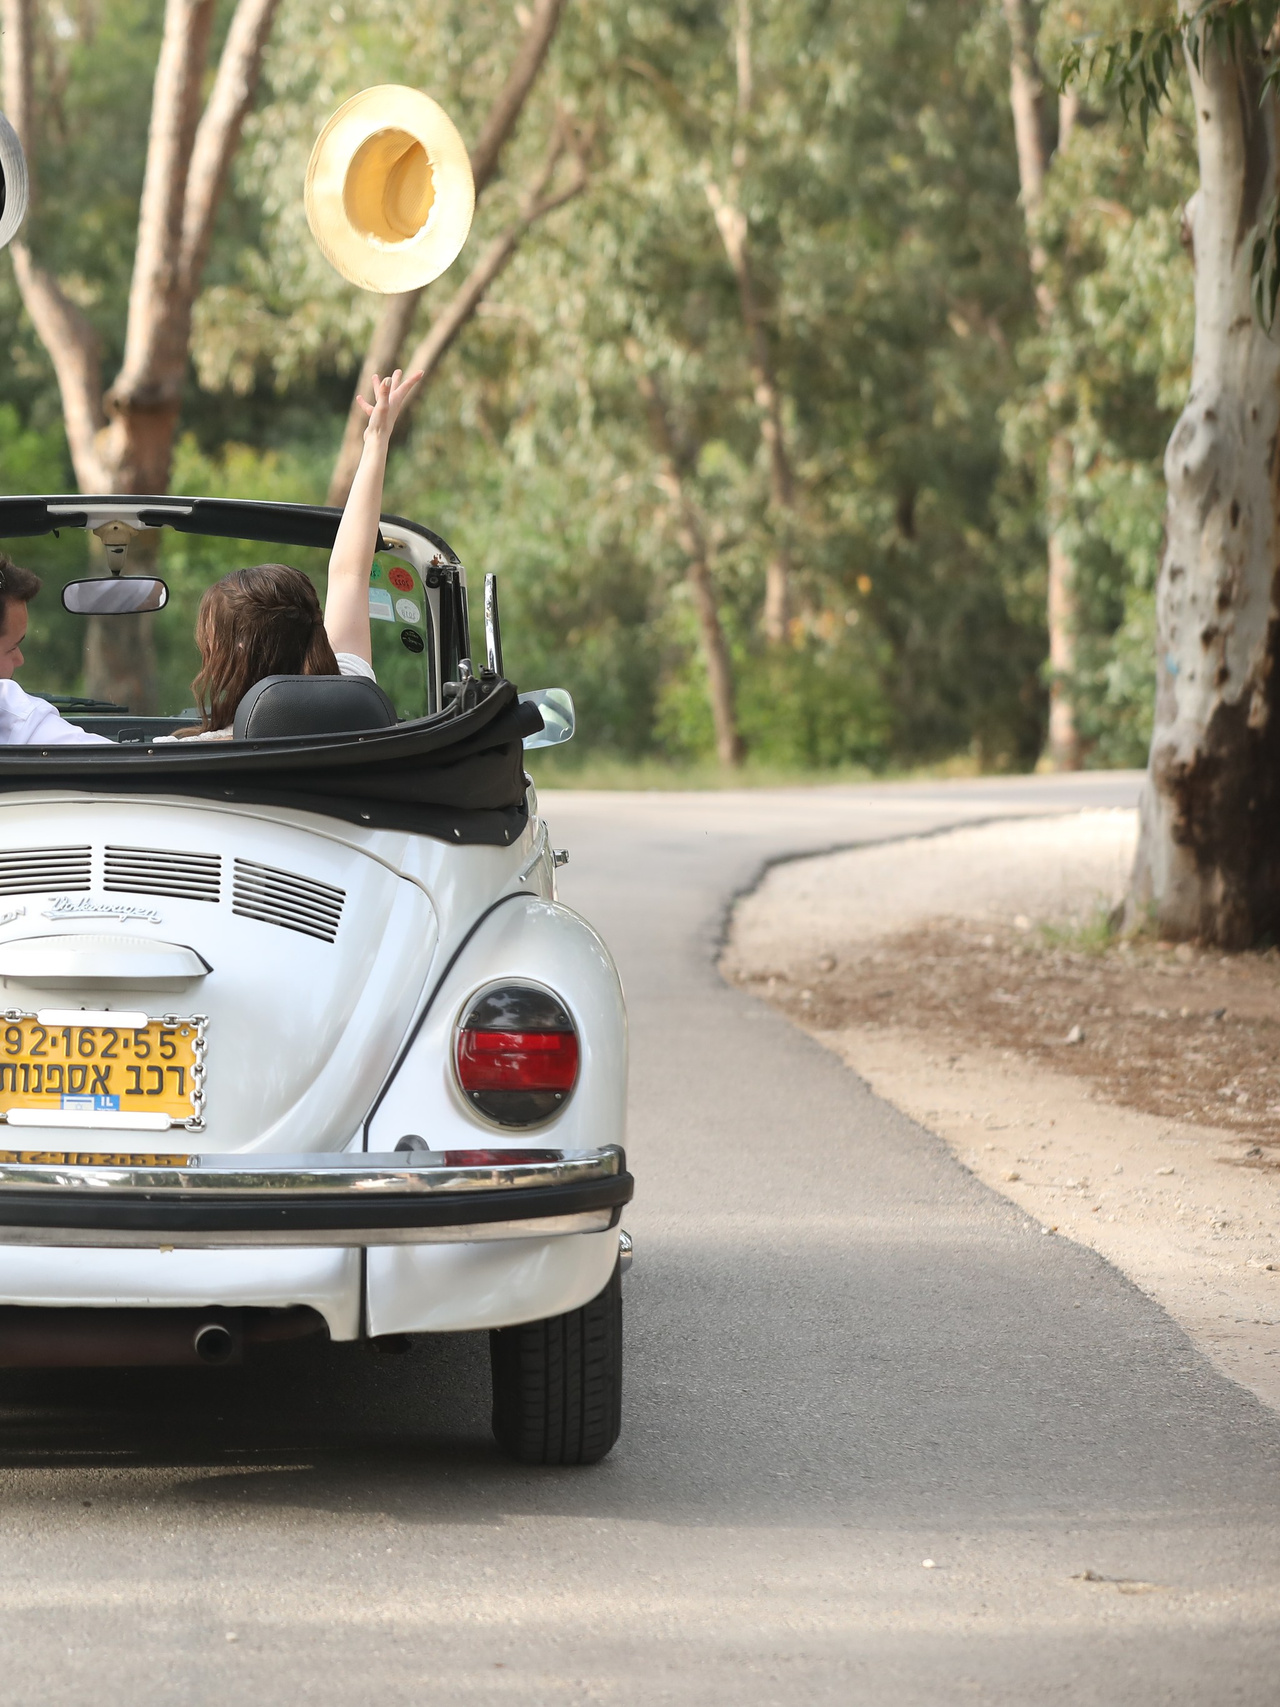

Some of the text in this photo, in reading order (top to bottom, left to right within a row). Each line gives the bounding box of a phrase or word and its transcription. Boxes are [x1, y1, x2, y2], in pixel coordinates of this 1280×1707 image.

[41, 896, 163, 924] Volkswagen
[124, 1065, 186, 1095] רכב
[100, 1096, 114, 1107] IL
